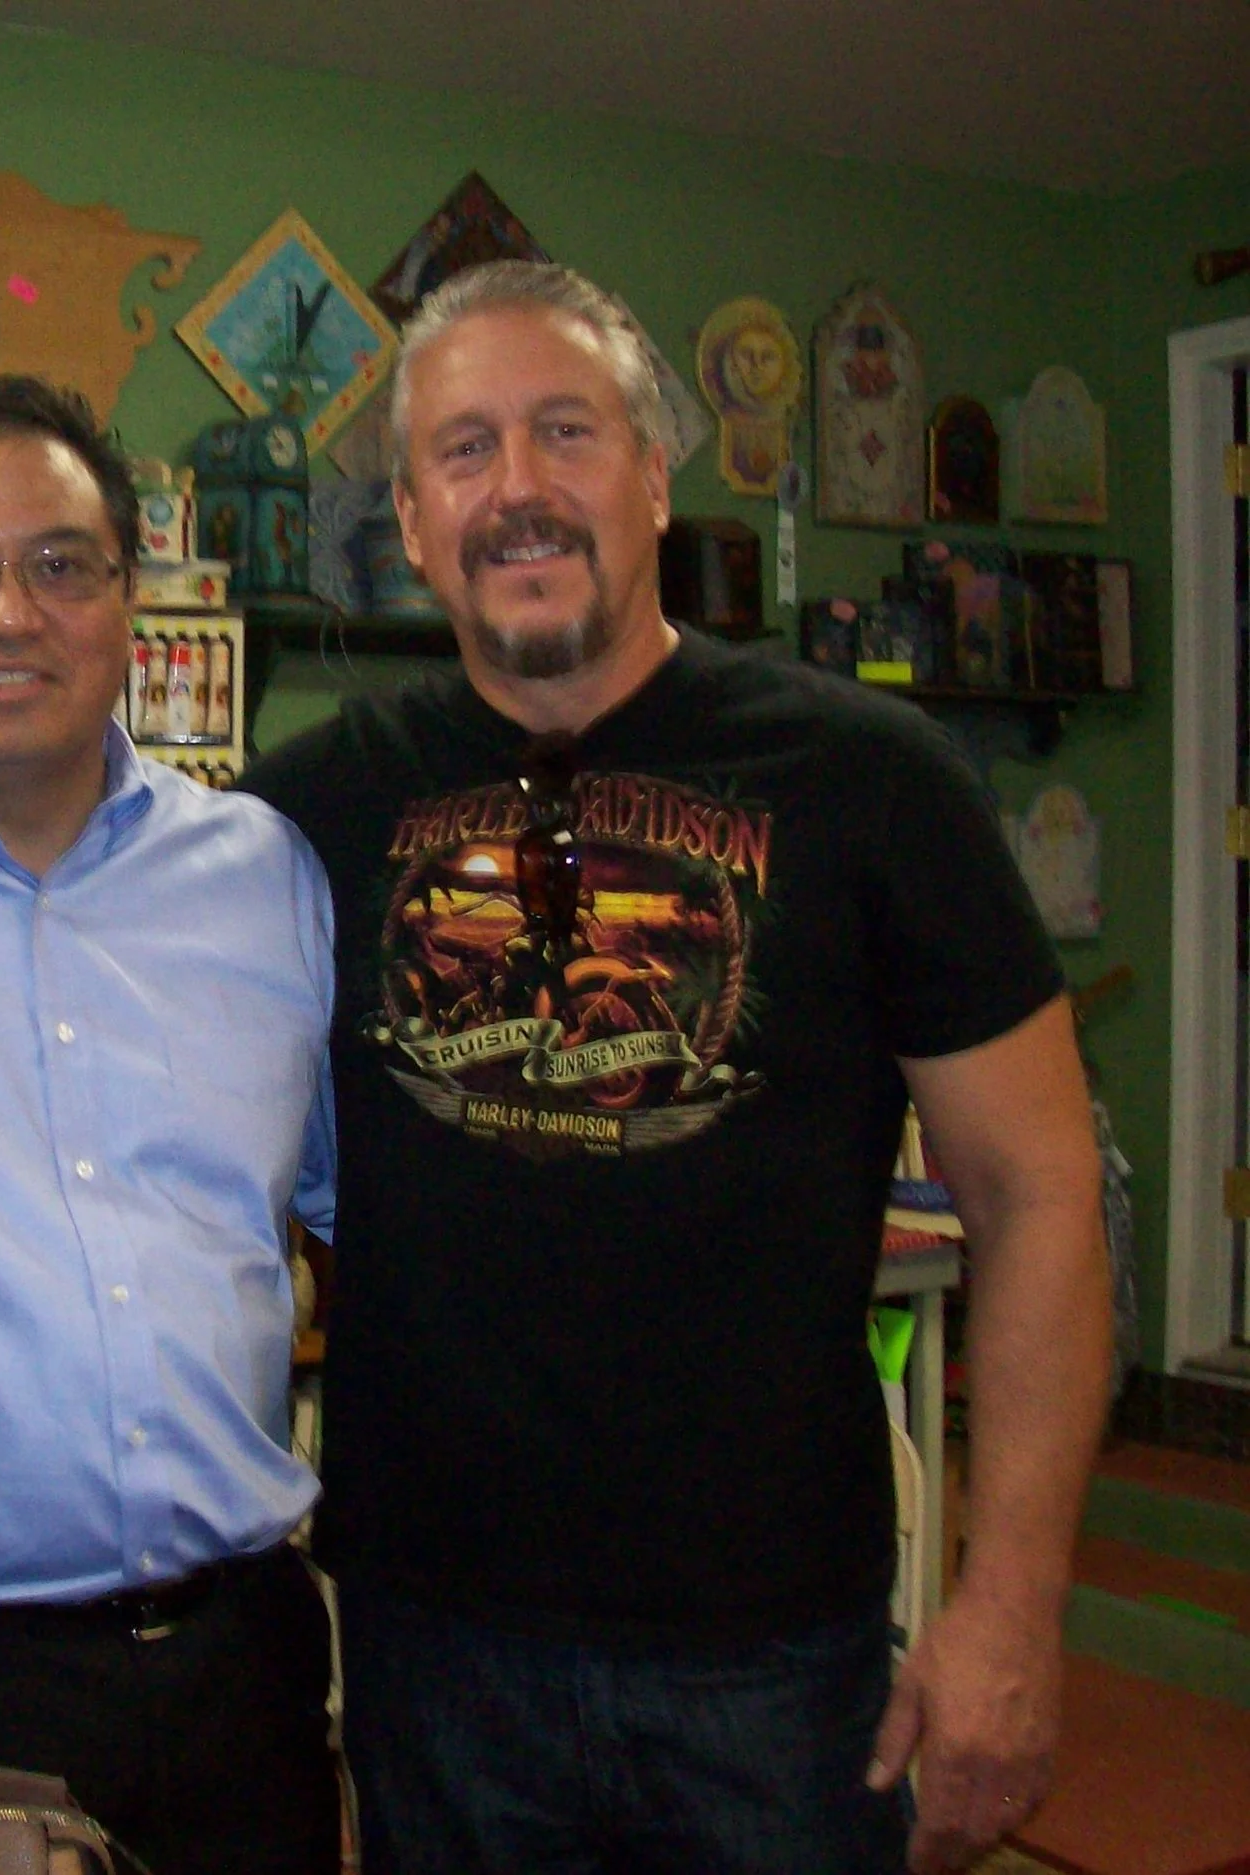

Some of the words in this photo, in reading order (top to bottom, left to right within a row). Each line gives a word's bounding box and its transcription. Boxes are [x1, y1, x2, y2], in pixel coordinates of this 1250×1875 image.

[423, 1024, 534, 1065] CRUISIN
[546, 1045, 610, 1079] SUNRISE
[611, 1042, 626, 1061] TO
[628, 1032, 676, 1060] SUNS
